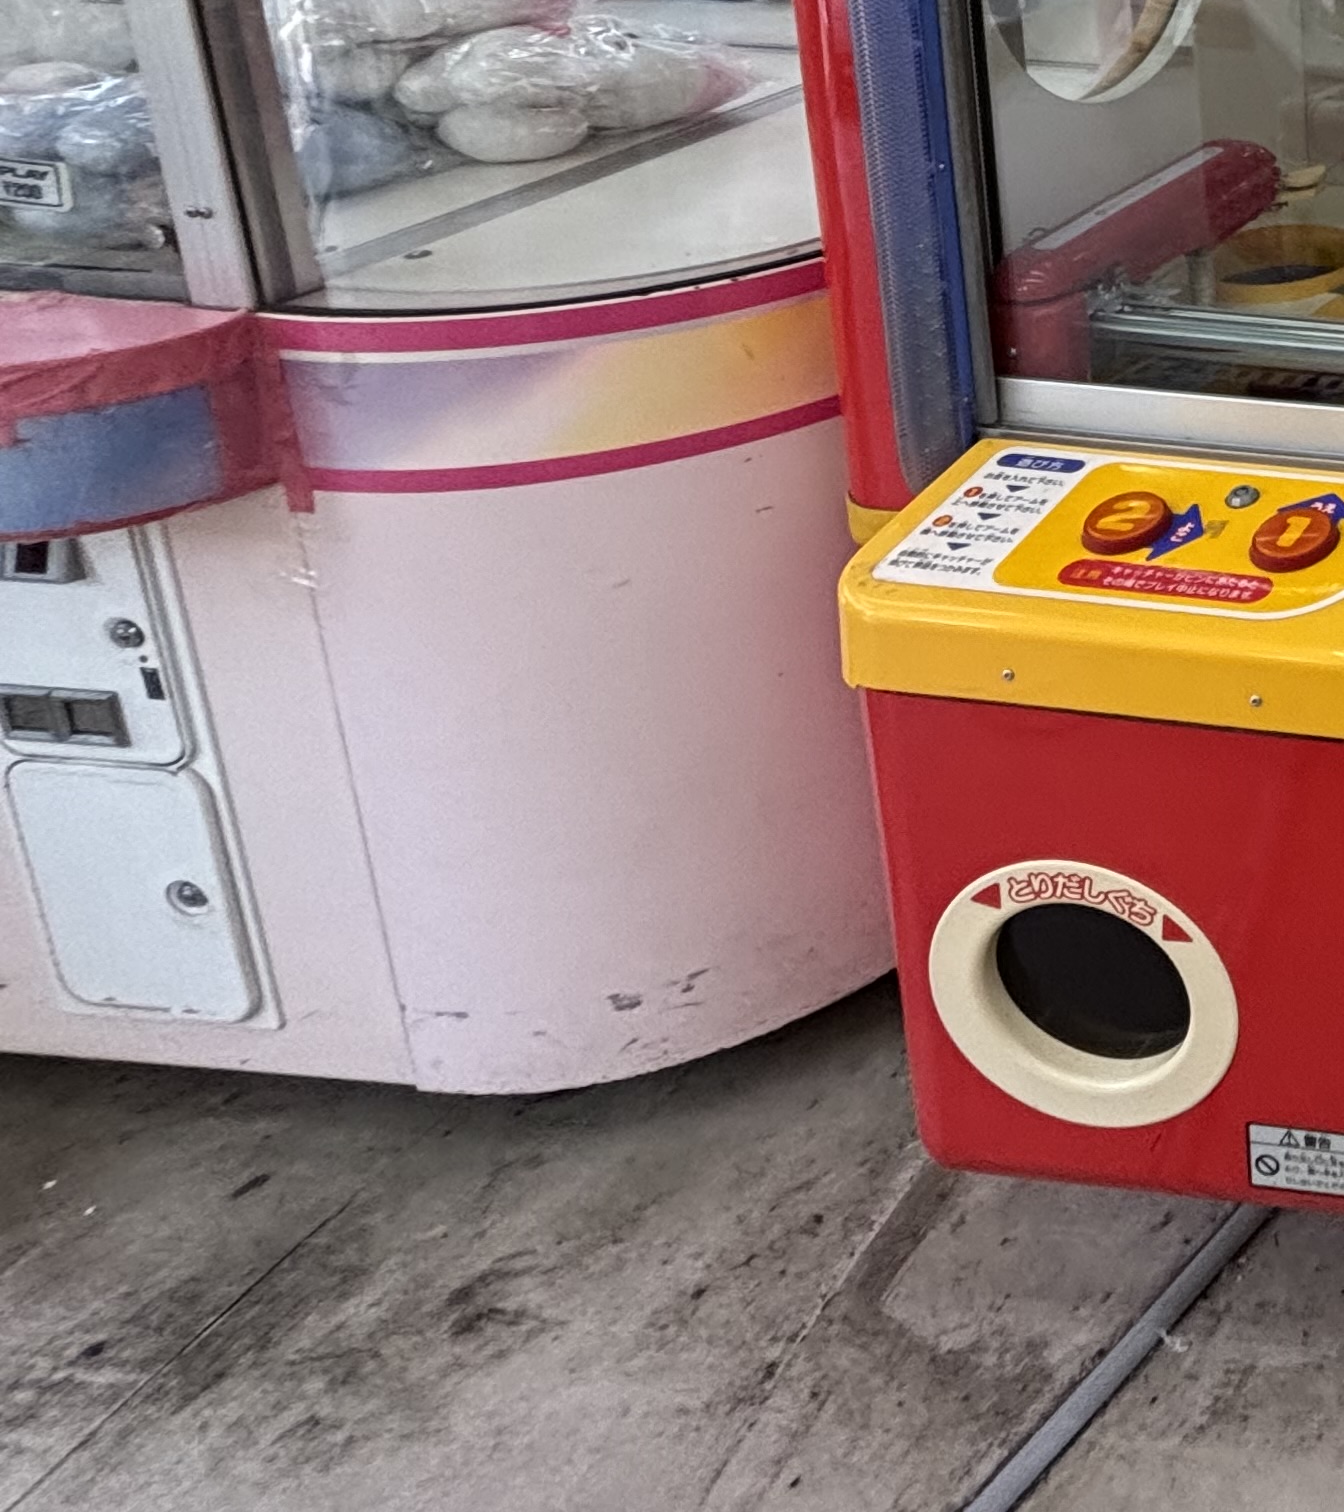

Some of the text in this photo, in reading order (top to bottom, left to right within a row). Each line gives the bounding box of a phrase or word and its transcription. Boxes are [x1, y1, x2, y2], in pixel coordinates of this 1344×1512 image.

[1096, 499, 1150, 532] 2
[1275, 515, 1311, 548] 1
[1006, 871, 1158, 927] とりだしぐち
